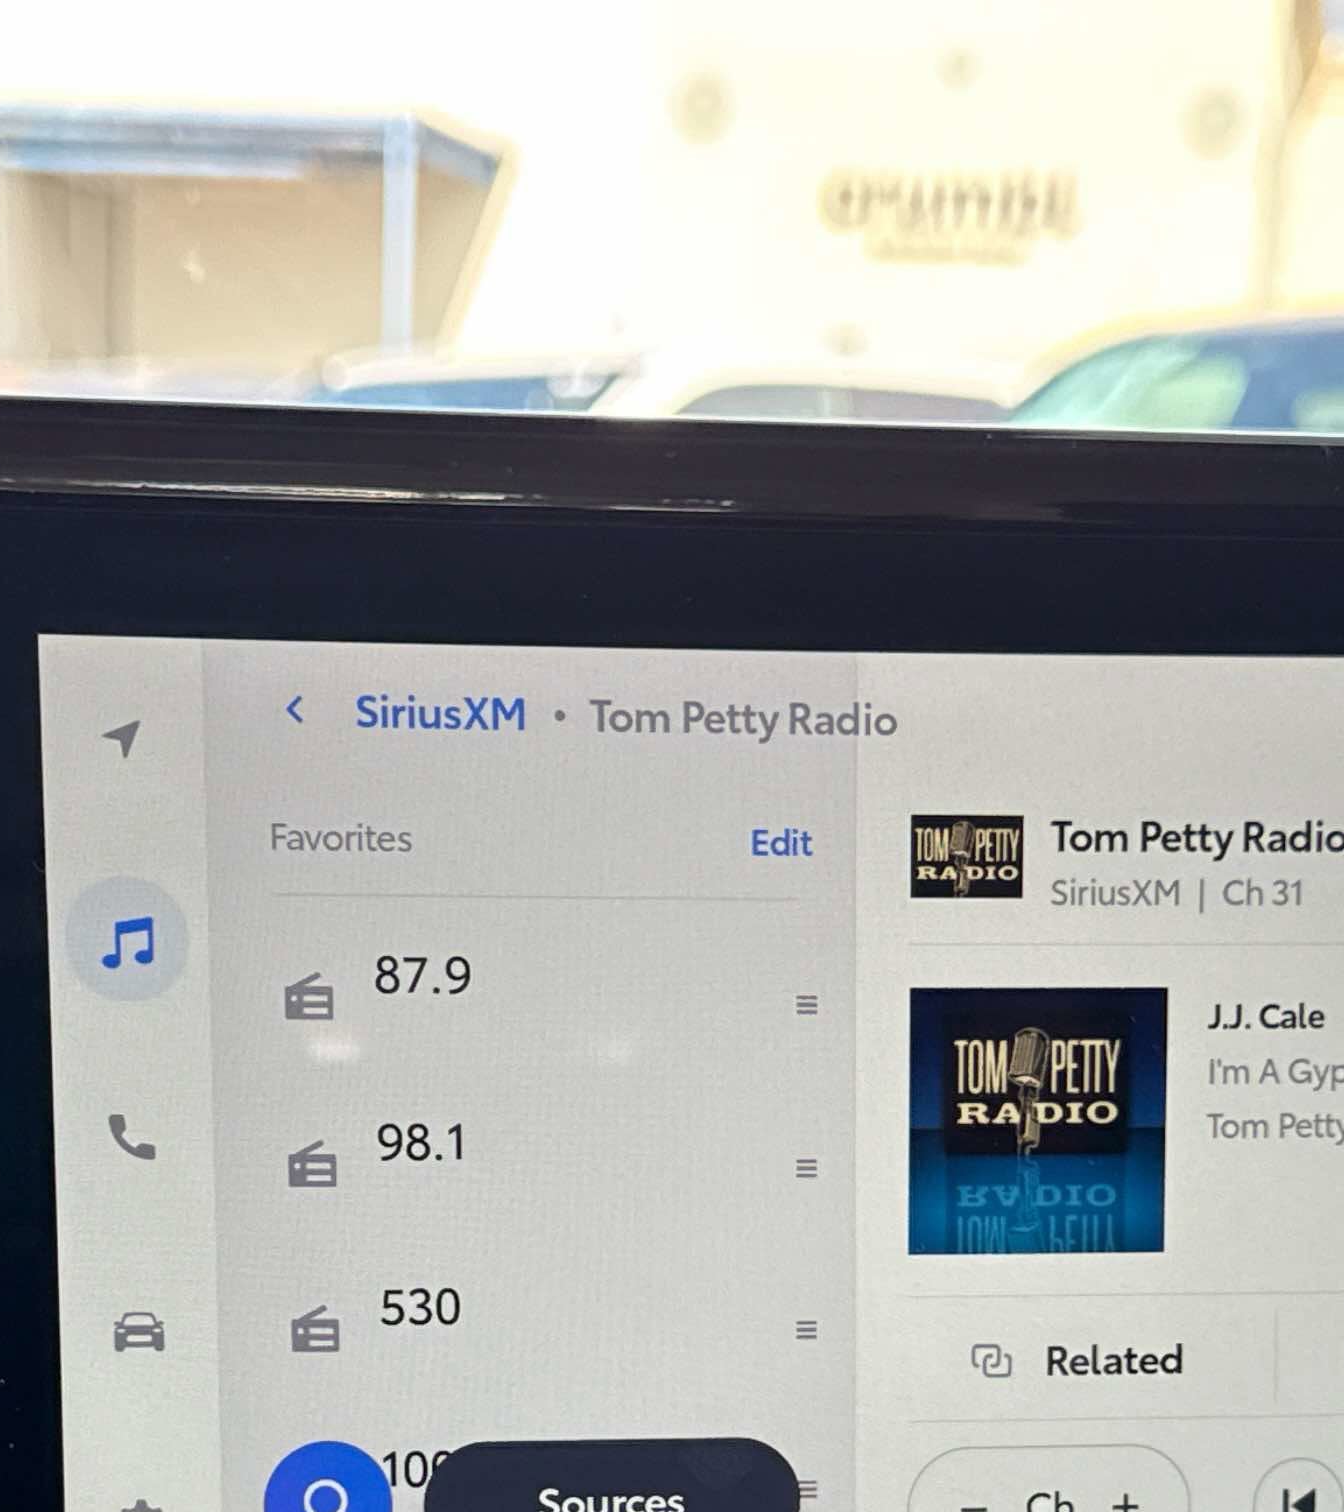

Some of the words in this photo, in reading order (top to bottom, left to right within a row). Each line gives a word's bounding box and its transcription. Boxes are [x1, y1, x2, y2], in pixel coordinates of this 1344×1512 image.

[356, 695, 527, 731] SiriusXM
[588, 699, 670, 736] Tom
[683, 702, 780, 744] Petty
[789, 702, 899, 739] Radio
[272, 824, 413, 854] Favorites
[751, 829, 814, 858] Edit
[915, 828, 950, 861] TOM
[976, 828, 1021, 861] PETTY
[1051, 821, 1129, 855] Tom
[1141, 822, 1231, 861] Petty
[917, 865, 1019, 881] RADIO
[1051, 879, 1180, 907] SiriusXM
[1222, 879, 1265, 907] Ch
[1272, 880, 1304, 907] 31
[375, 957, 472, 996] 87.9
[1207, 1004, 1252, 1031] J.J.
[1259, 1003, 1325, 1030] Cale
[954, 1040, 1008, 1095] TOM
[1051, 1039, 1121, 1095] PETTY
[1207, 1058, 1254, 1085] I'm
[1259, 1060, 1282, 1085] A
[956, 1101, 1119, 1125] RADIO
[1207, 1112, 1268, 1139] Tom
[377, 1123, 465, 1162] 98.1
[380, 1287, 462, 1327] 530
[1046, 1344, 1184, 1377] Related
